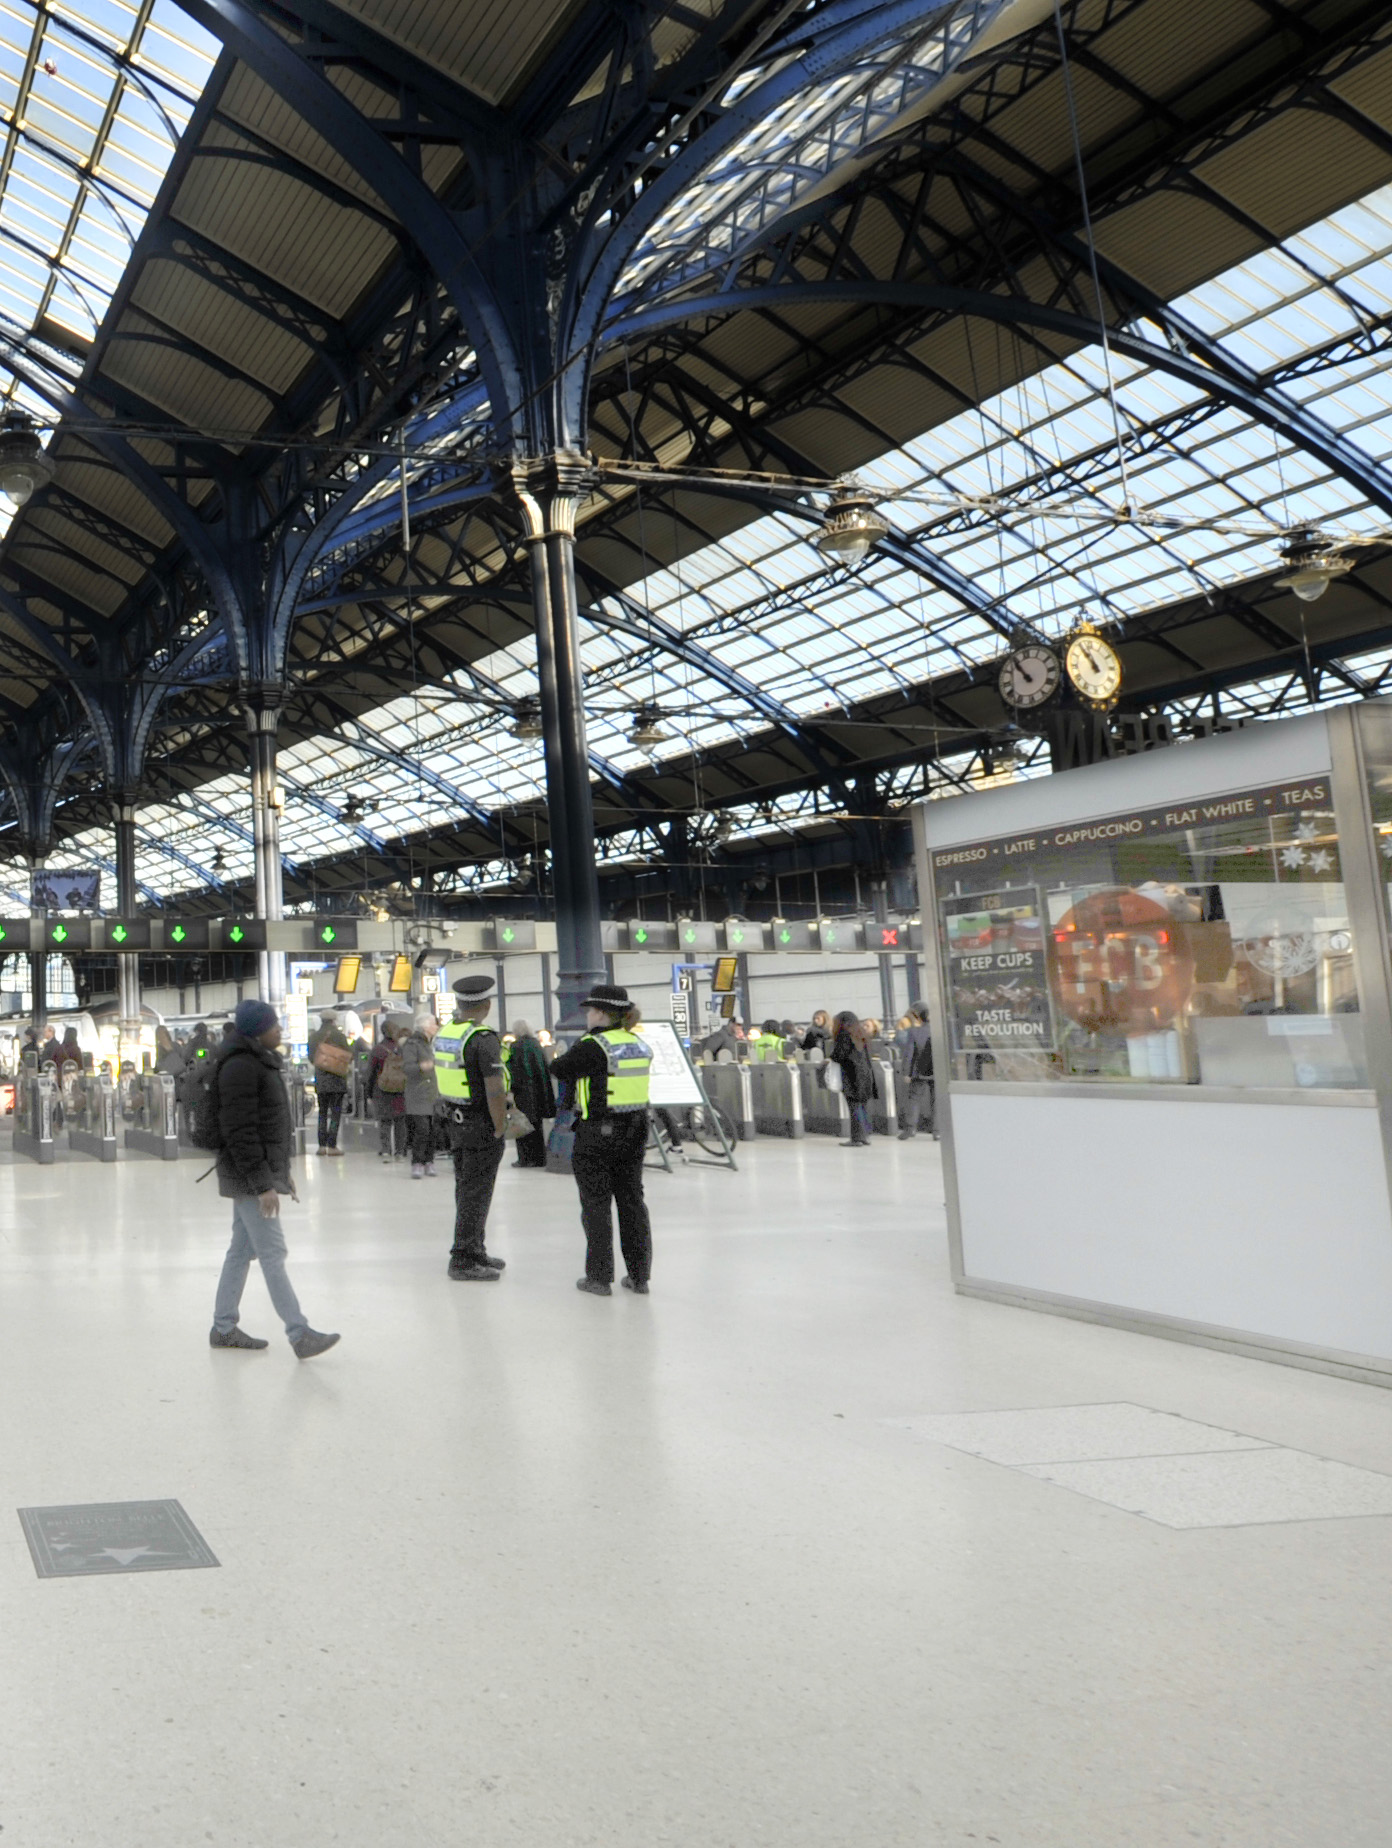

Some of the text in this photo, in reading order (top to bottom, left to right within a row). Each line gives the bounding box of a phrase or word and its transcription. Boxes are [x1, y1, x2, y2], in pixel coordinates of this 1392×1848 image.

[935, 786, 1325, 867] ESPRESSO LATTE CAPPUCCINO FLAT WHITE TEAS
[961, 952, 1033, 971] KEEP CUPS
[1072, 935, 1163, 994] FCB
[680, 979, 687, 990] 7
[675, 1013, 686, 1023] 30
[975, 1009, 1011, 1023] TASTE
[964, 1022, 1044, 1037] REVOLUTION
